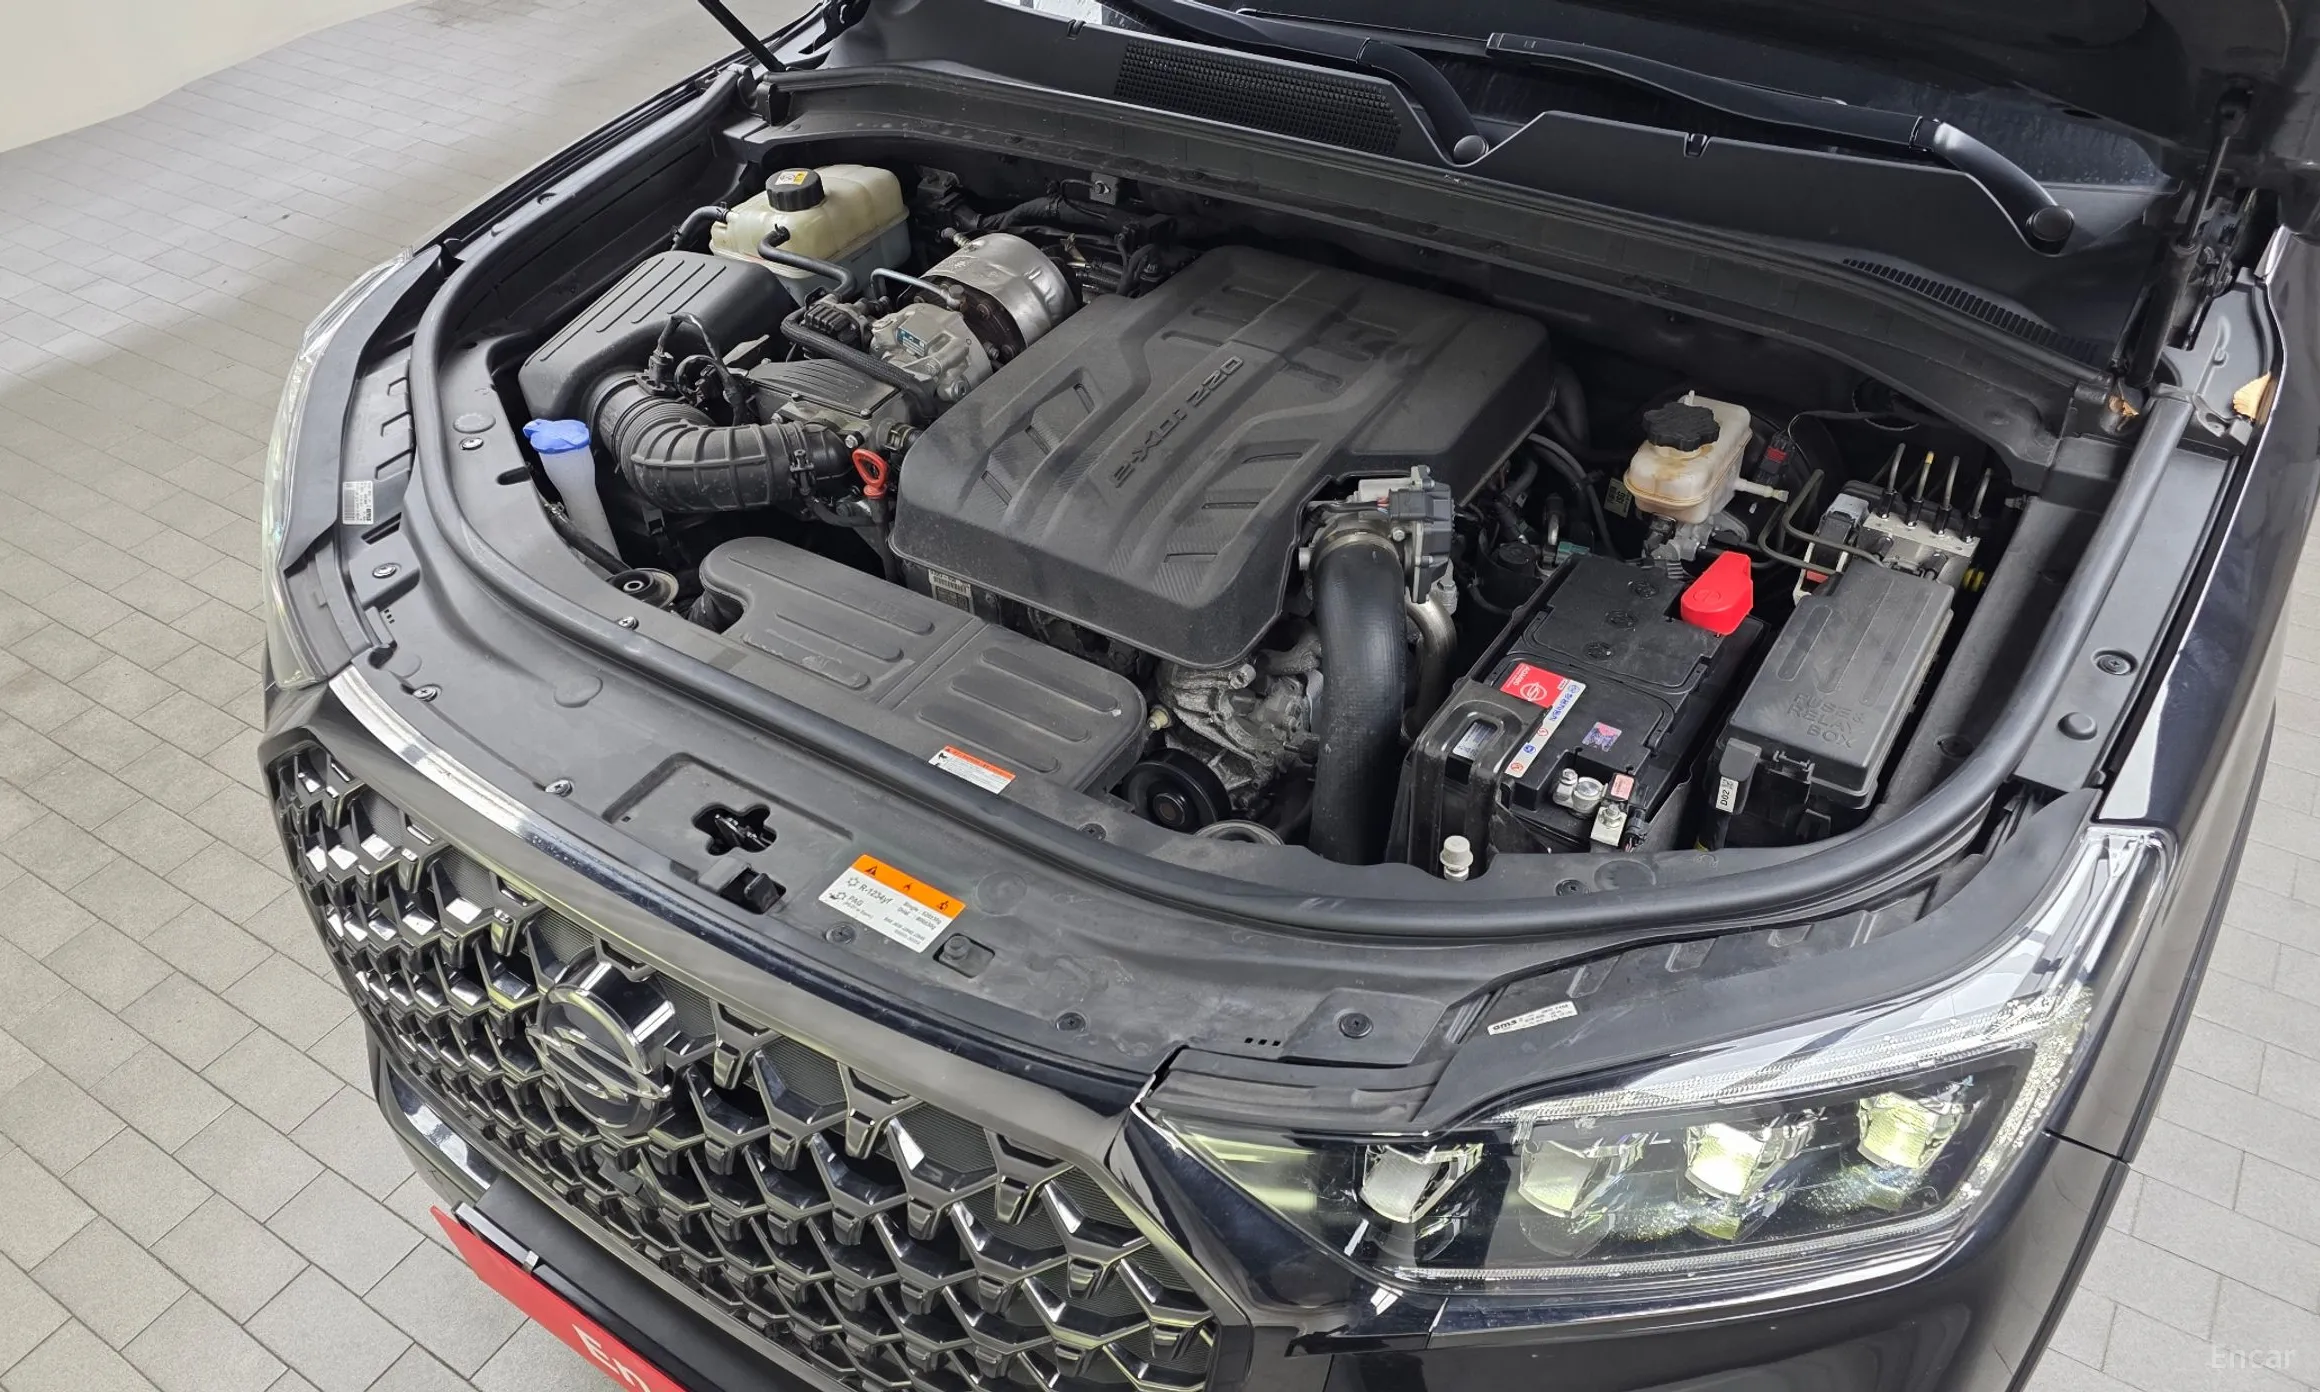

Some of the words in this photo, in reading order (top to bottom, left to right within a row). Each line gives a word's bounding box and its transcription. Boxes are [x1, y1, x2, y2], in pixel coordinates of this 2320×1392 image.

[1185, 354, 1245, 408] 220
[1793, 692, 1852, 718] FUSE
[1806, 722, 1852, 749] BOX
[848, 896, 865, 907] PAG
[858, 884, 894, 904] R-1234yf
